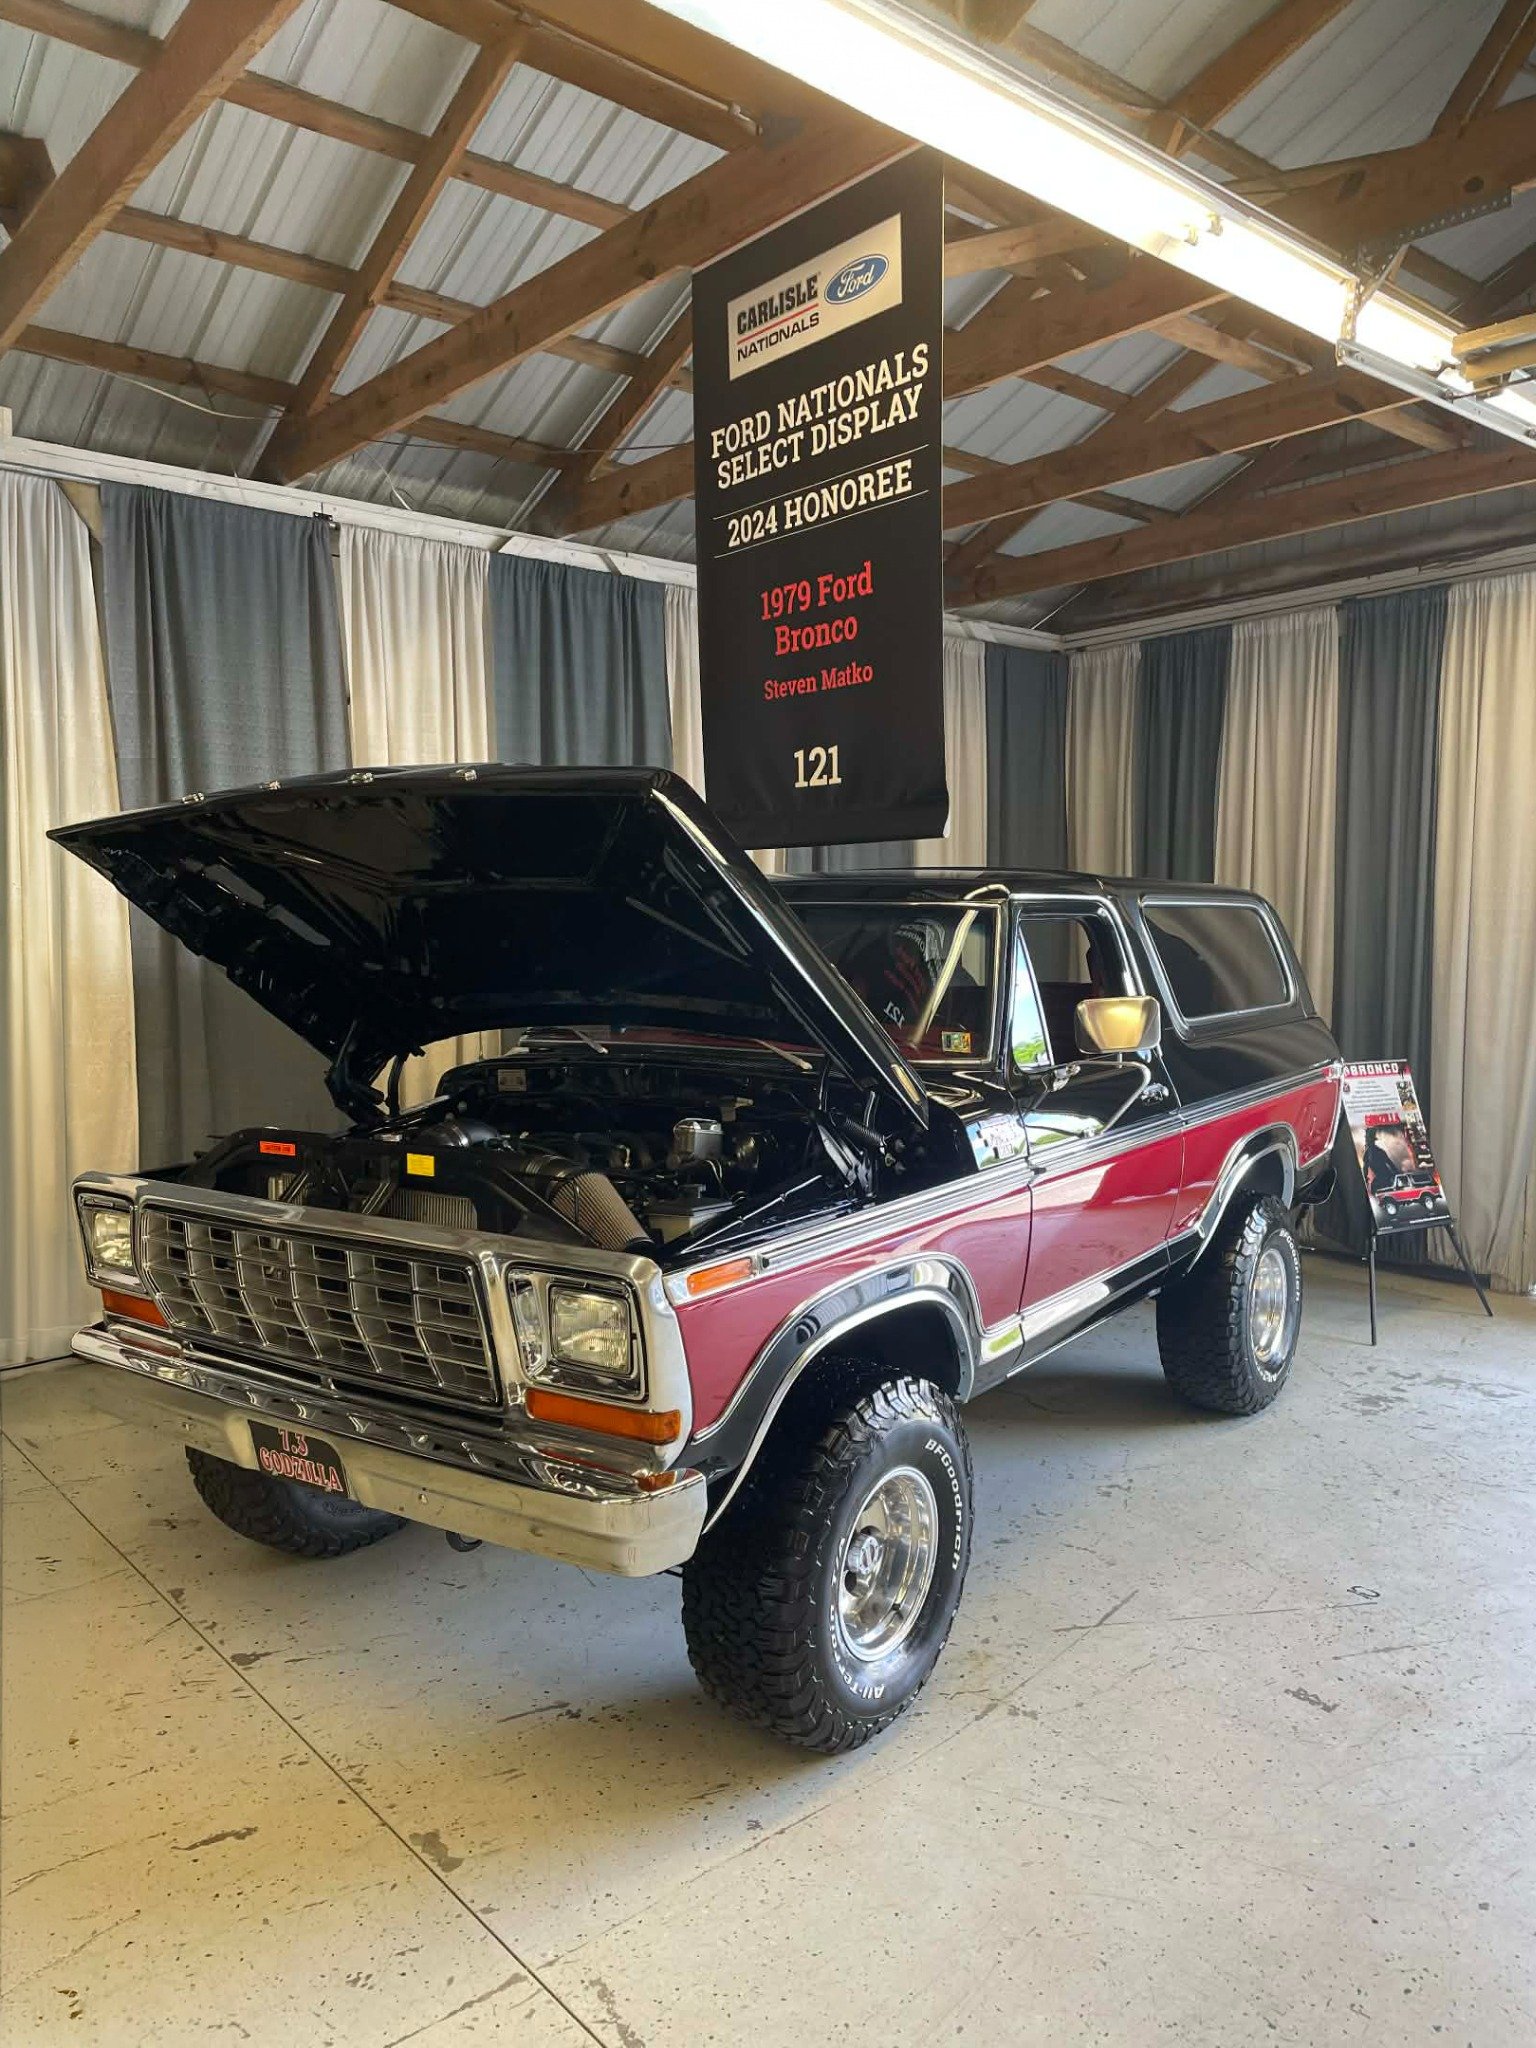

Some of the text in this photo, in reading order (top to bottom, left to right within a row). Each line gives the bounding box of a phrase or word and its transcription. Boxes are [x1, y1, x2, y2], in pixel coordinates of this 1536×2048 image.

[736, 276, 819, 335] CARLISLE
[836, 261, 875, 299] Ford
[736, 311, 820, 363] NATIONALS
[710, 342, 929, 460] FORD NATIONALS
[716, 383, 923, 490] SELECT DISPLAY
[727, 458, 913, 548] 2024 HONOREE
[760, 560, 874, 622] 1979 Ford
[774, 615, 859, 657] Bronco
[763, 661, 874, 701] Steven Matko
[793, 744, 843, 789] 121
[259, 1446, 344, 1492] GODZILLA
[924, 1438, 963, 1571] BFGoodrich
